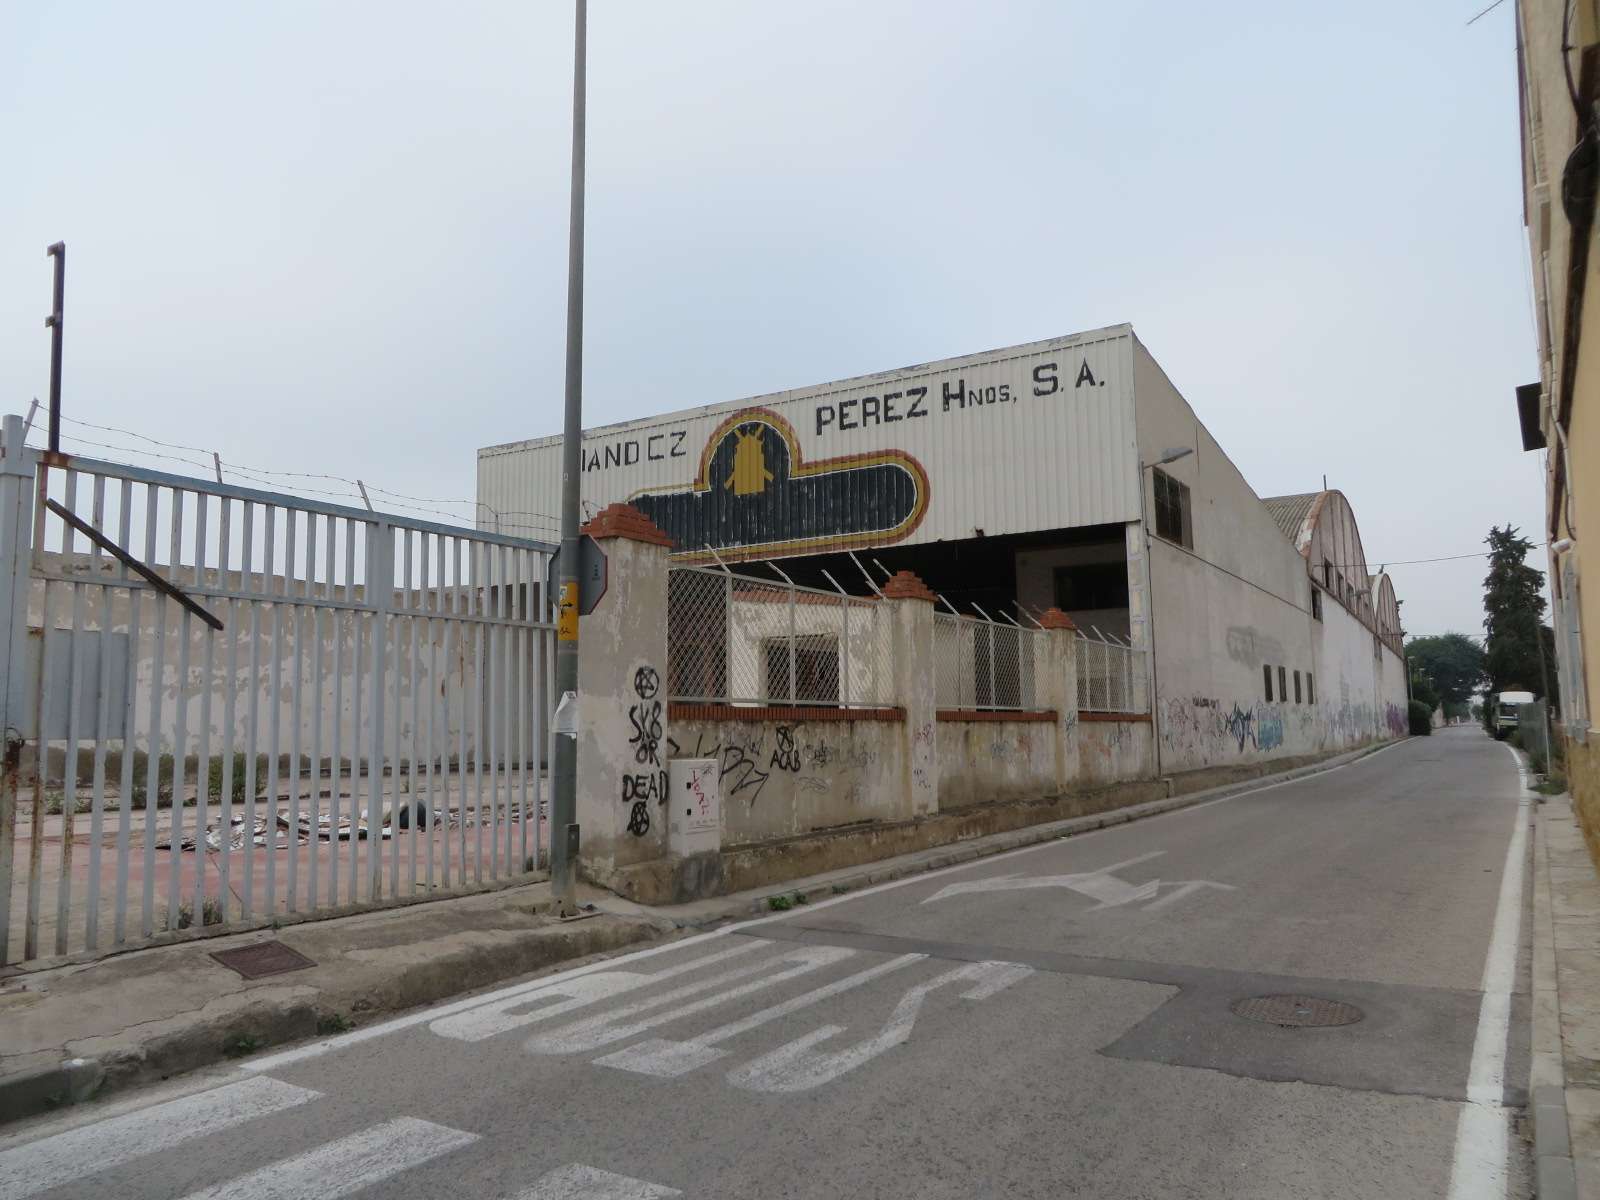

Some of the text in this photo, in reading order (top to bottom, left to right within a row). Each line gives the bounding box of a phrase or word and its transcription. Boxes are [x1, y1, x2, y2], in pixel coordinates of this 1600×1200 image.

[815, 386, 928, 436] PEREZ
[622, 770, 670, 806] DEAD
[428, 939, 1036, 1093] STOP
